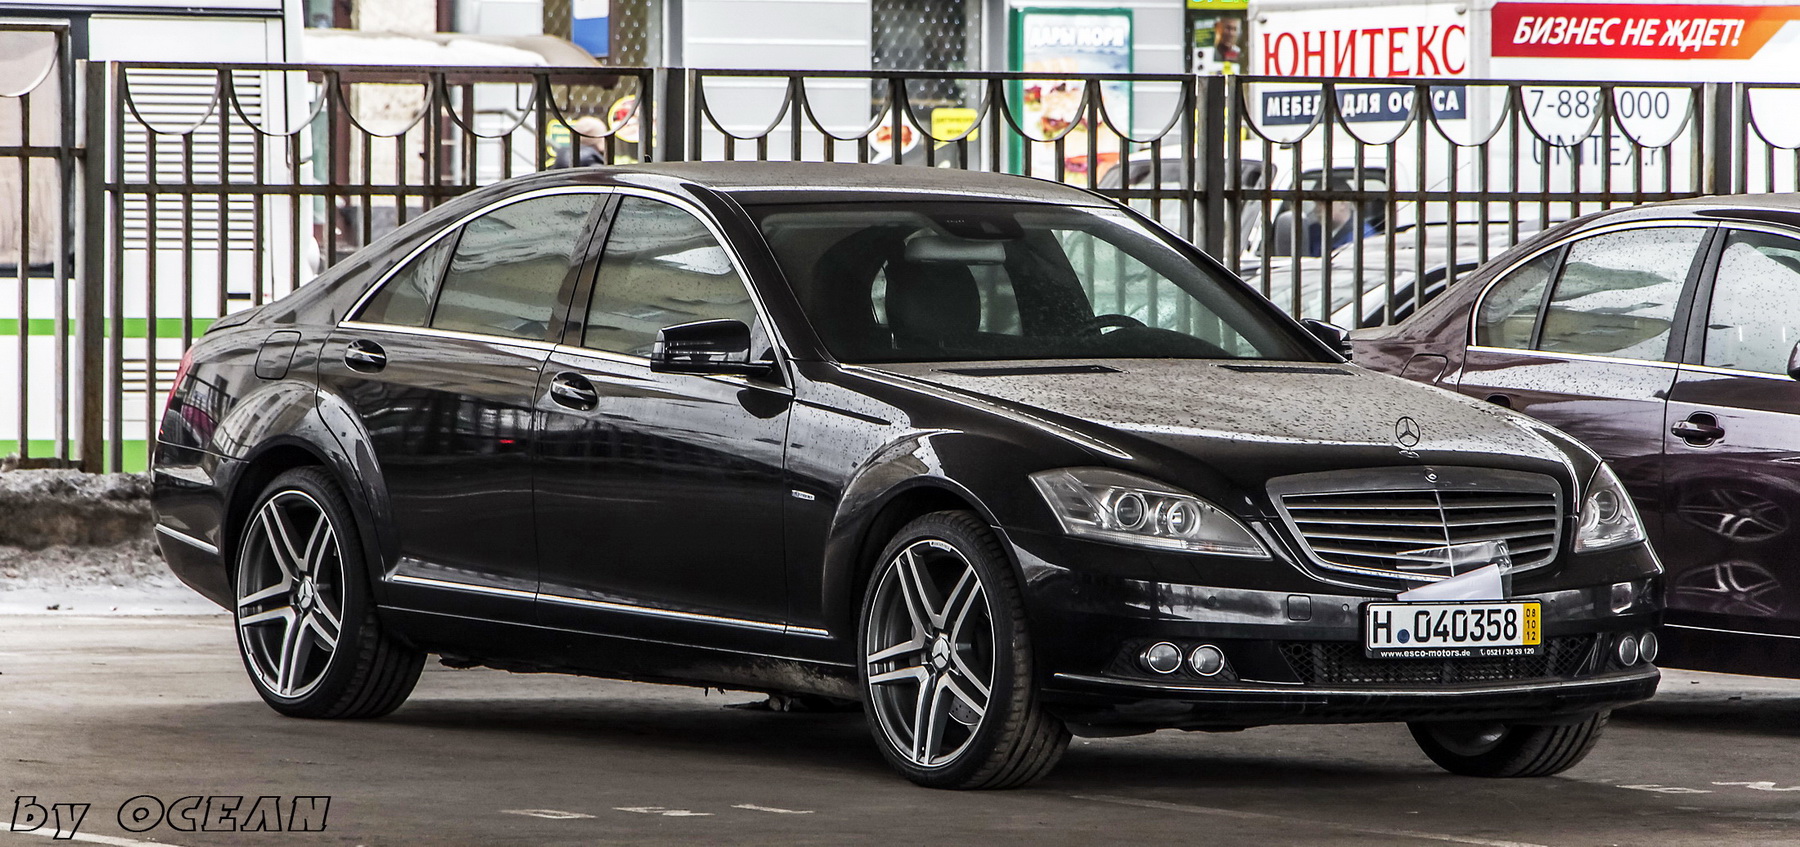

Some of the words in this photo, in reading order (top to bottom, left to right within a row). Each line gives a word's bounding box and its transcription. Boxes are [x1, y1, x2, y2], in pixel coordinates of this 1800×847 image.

[1513, 16, 1614, 45] БИЗНЕС
[1619, 18, 1661, 46] НЕ
[1658, 18, 1745, 52] ЖДЕТ!
[1263, 25, 1466, 77] ЮНИТЕКС
[1342, 92, 1381, 118] ДЛЯ
[1525, 608, 1536, 618] 08
[1373, 611, 1391, 644] H
[1414, 608, 1517, 643] 040358
[1526, 620, 1536, 629] 10
[1526, 631, 1536, 641] 12
[1381, 649, 1471, 658] www.esco-motors.de
